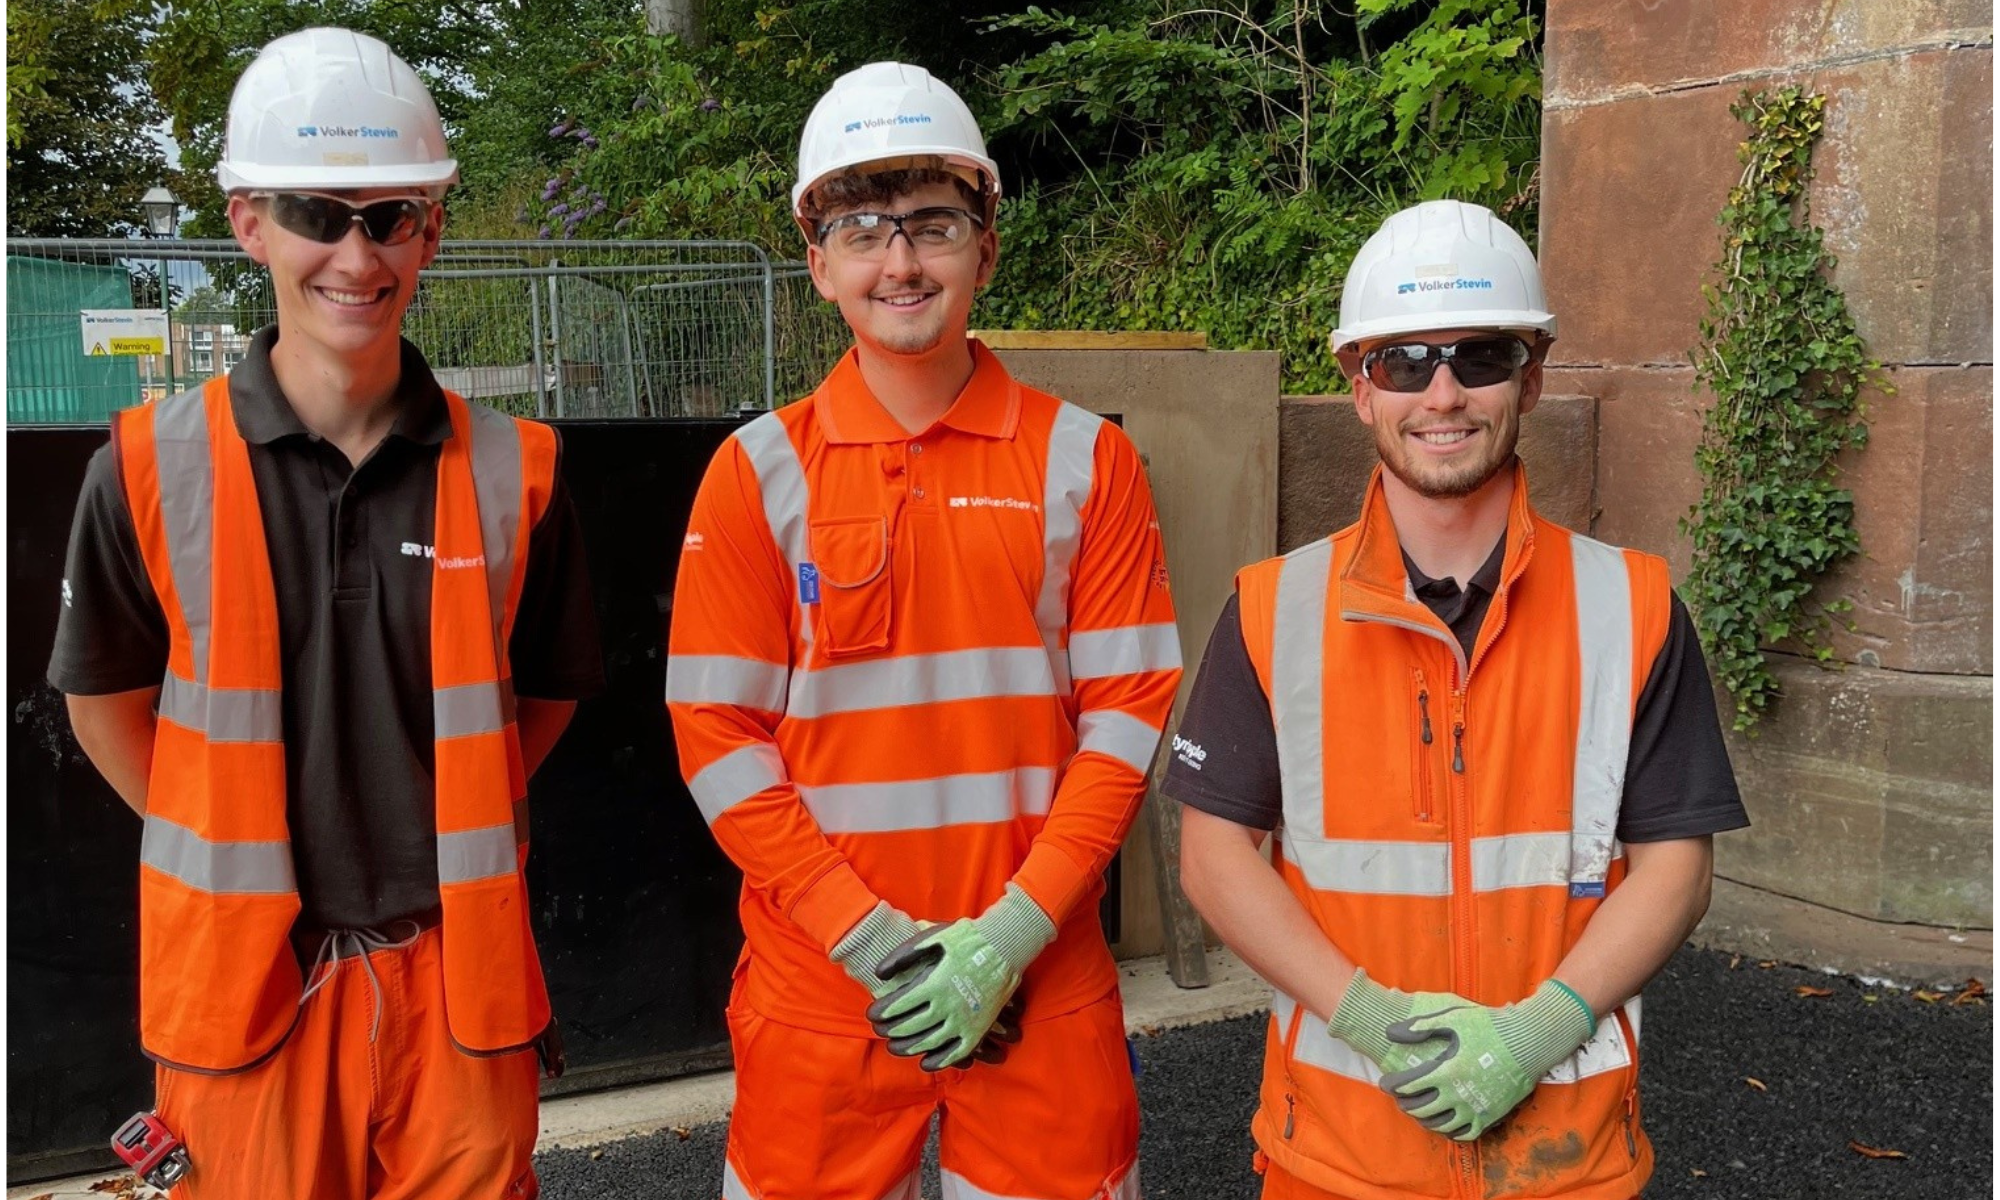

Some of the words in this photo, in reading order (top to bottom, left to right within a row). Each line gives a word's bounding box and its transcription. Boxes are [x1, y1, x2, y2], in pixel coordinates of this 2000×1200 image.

[862, 114, 932, 129] VolkerStevin
[319, 126, 399, 138] VolkerStevin
[1418, 278, 1493, 292] VolkerStevin
[951, 975, 977, 1008] SKYTEC
